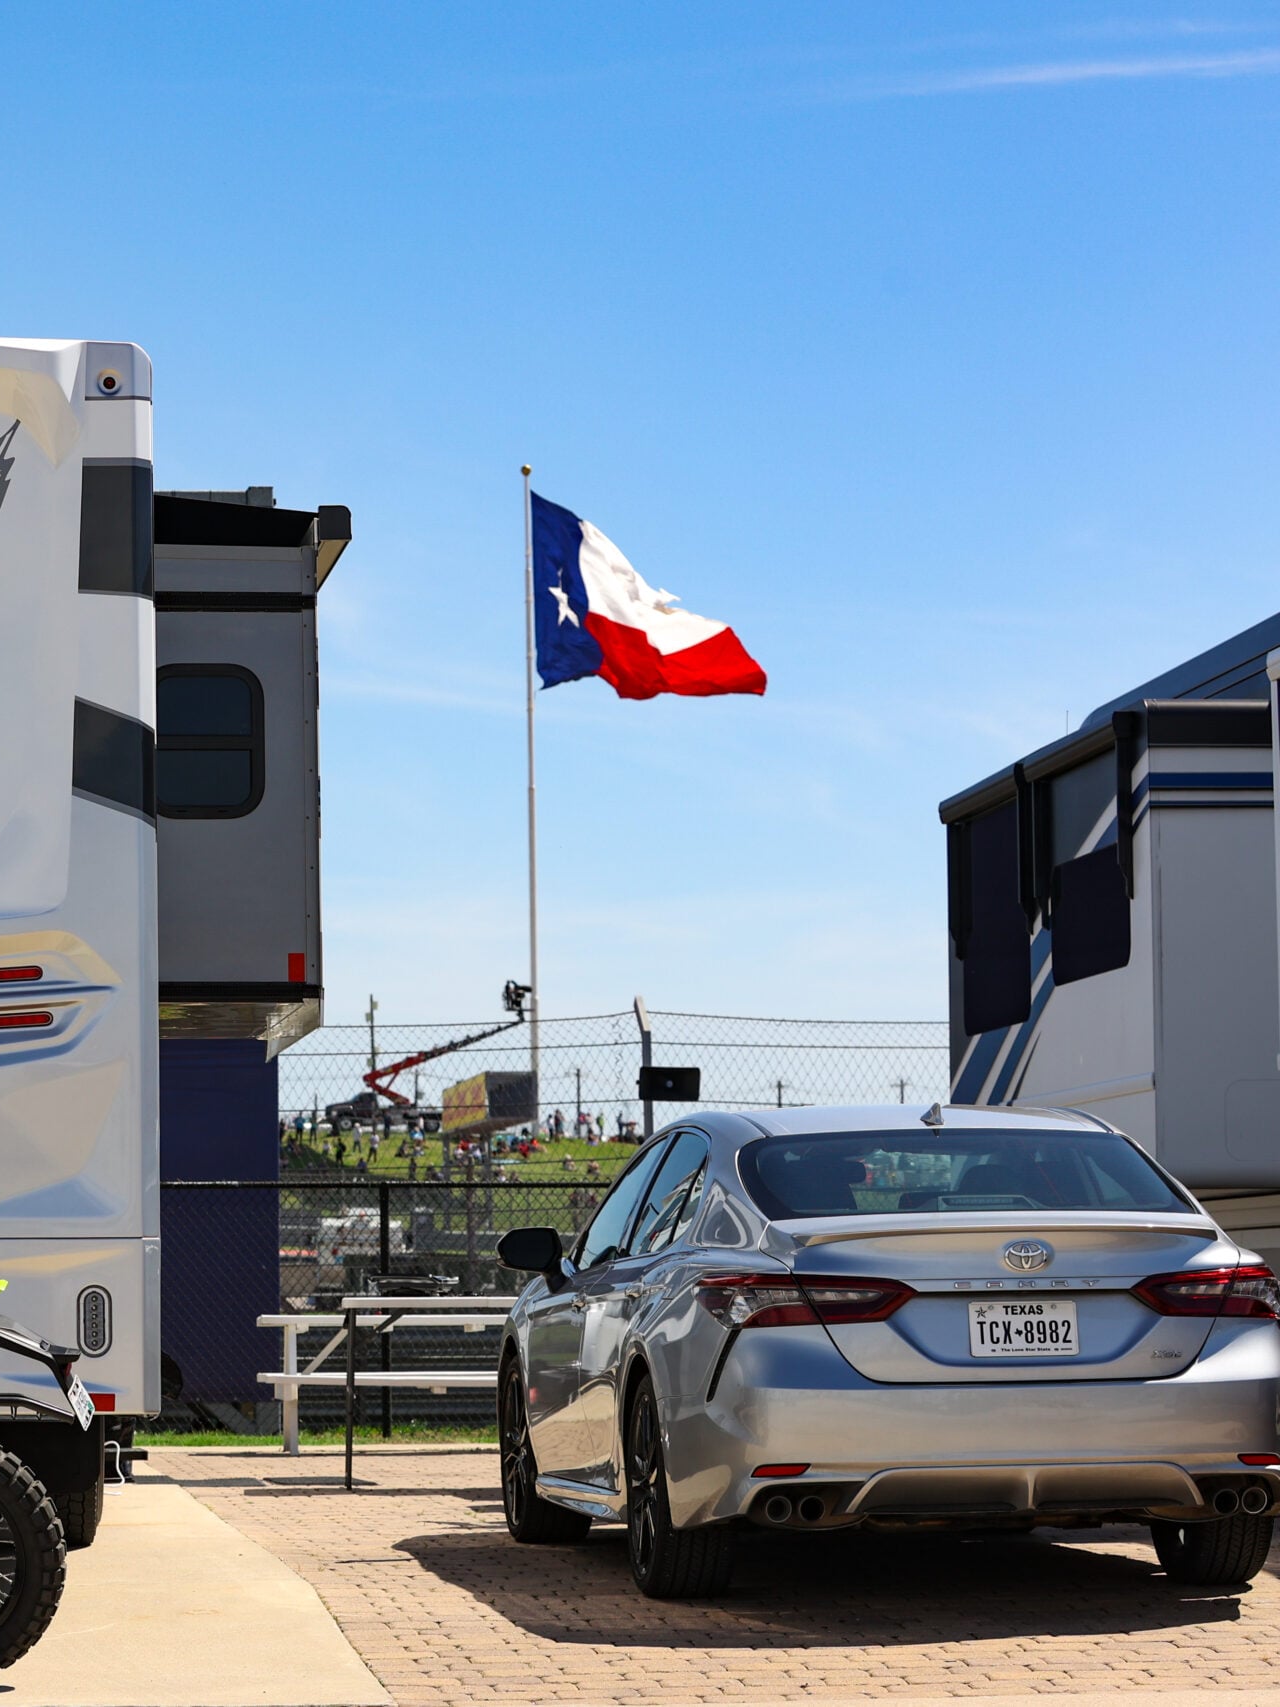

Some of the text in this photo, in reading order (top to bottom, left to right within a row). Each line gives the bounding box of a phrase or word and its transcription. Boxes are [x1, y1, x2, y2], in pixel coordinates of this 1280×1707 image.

[954, 1280, 1101, 1288] CAMRY
[1003, 1305, 1044, 1316] TEXAS
[976, 1320, 1072, 1345] TCX 8982
